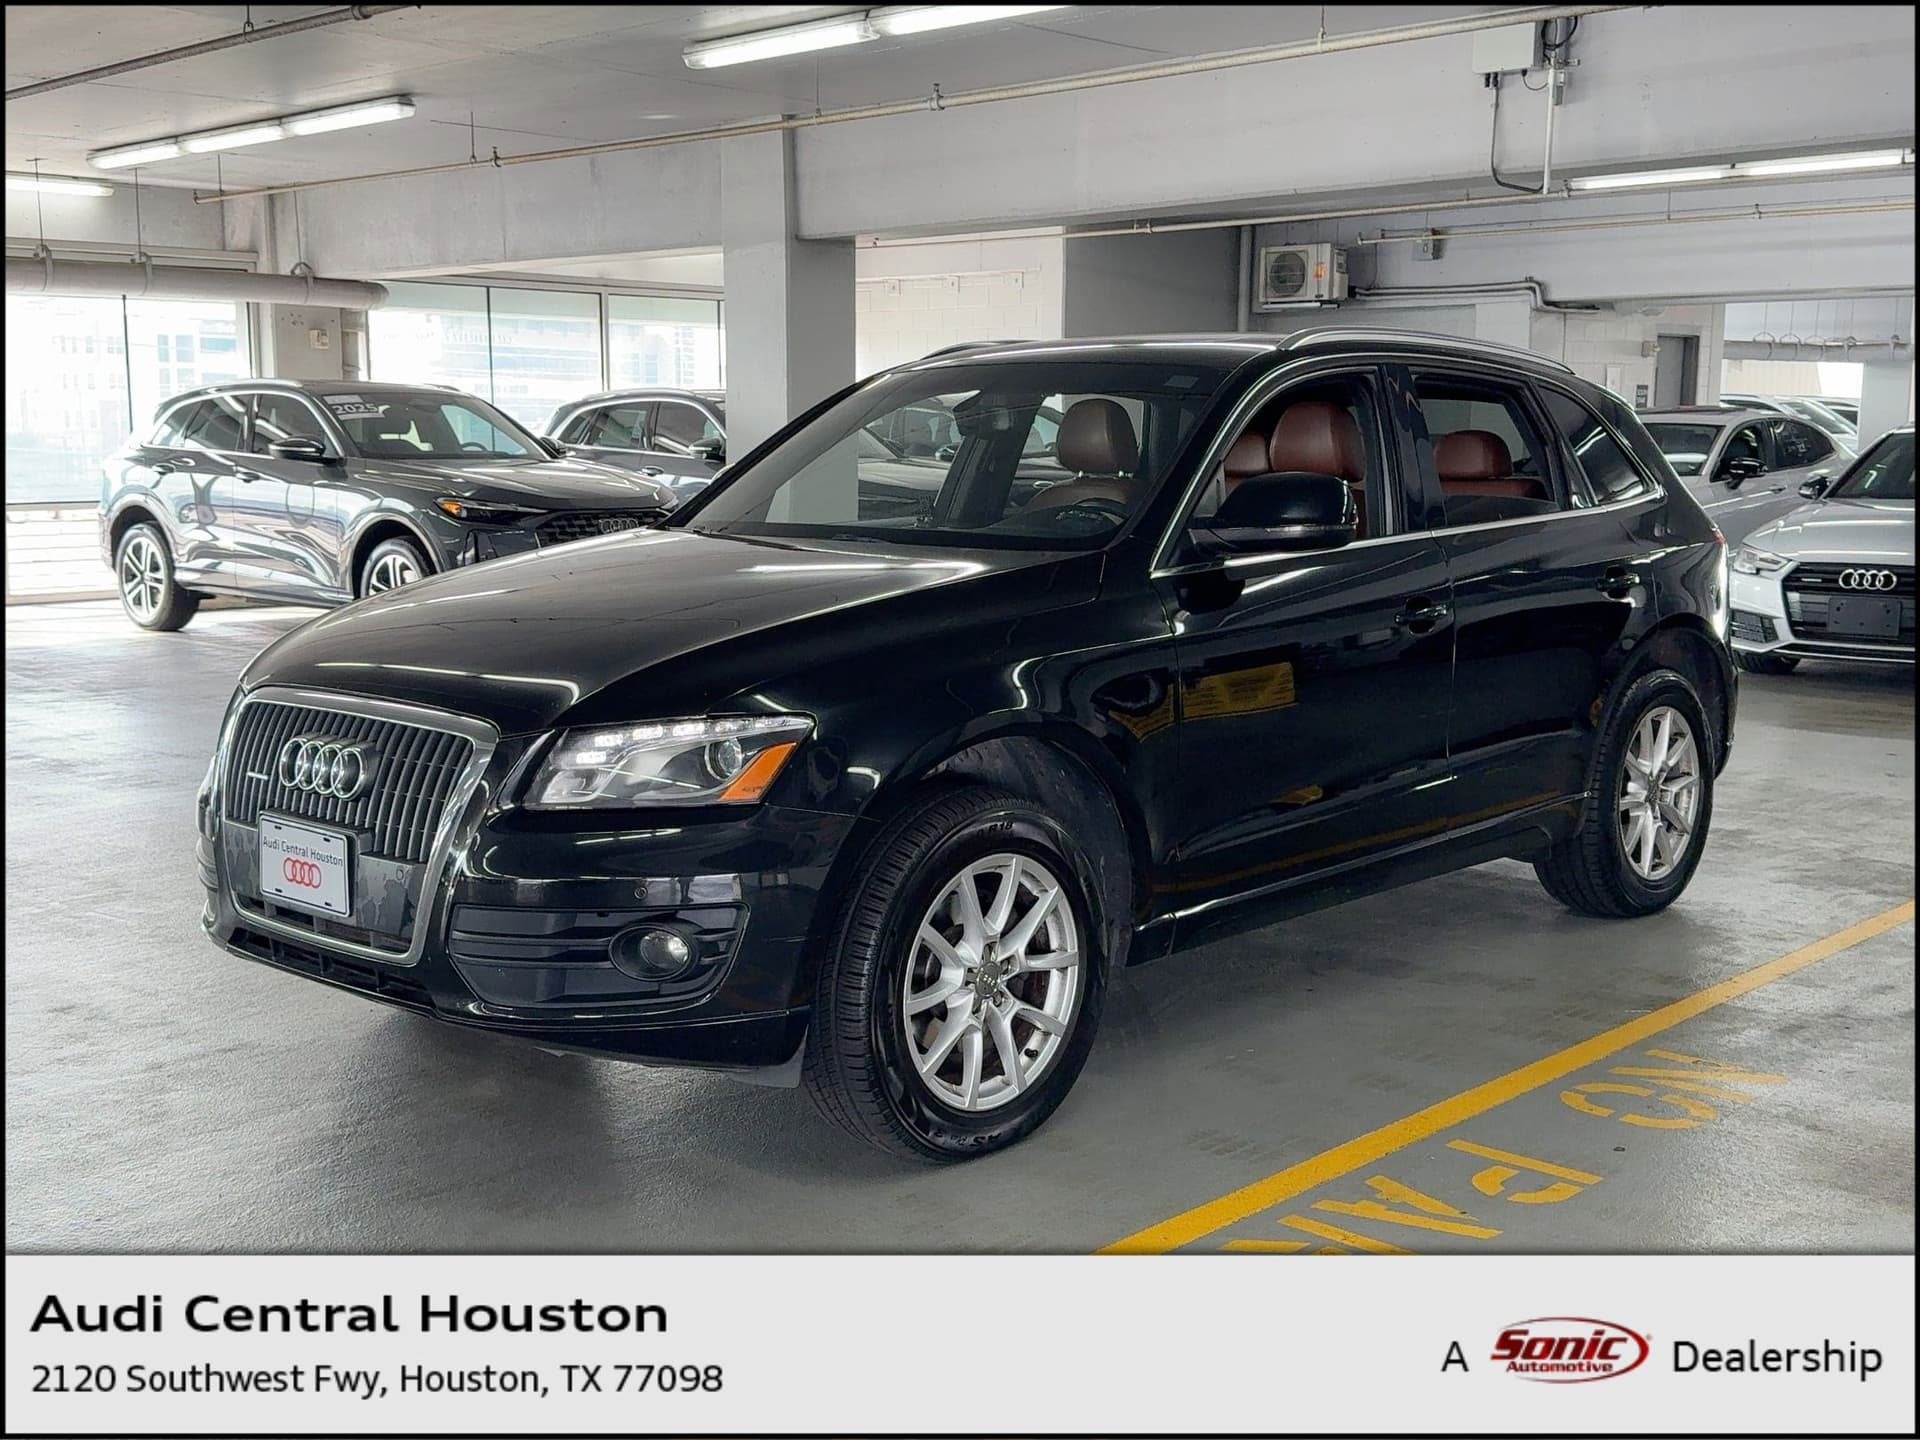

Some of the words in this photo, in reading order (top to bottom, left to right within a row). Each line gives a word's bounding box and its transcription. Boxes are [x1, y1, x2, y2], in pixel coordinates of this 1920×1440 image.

[332, 403, 378, 414] 2025
[263, 836, 280, 850] Audi
[281, 841, 309, 857] Central
[310, 848, 343, 867] Houston
[1559, 1047, 1788, 1130] NO
